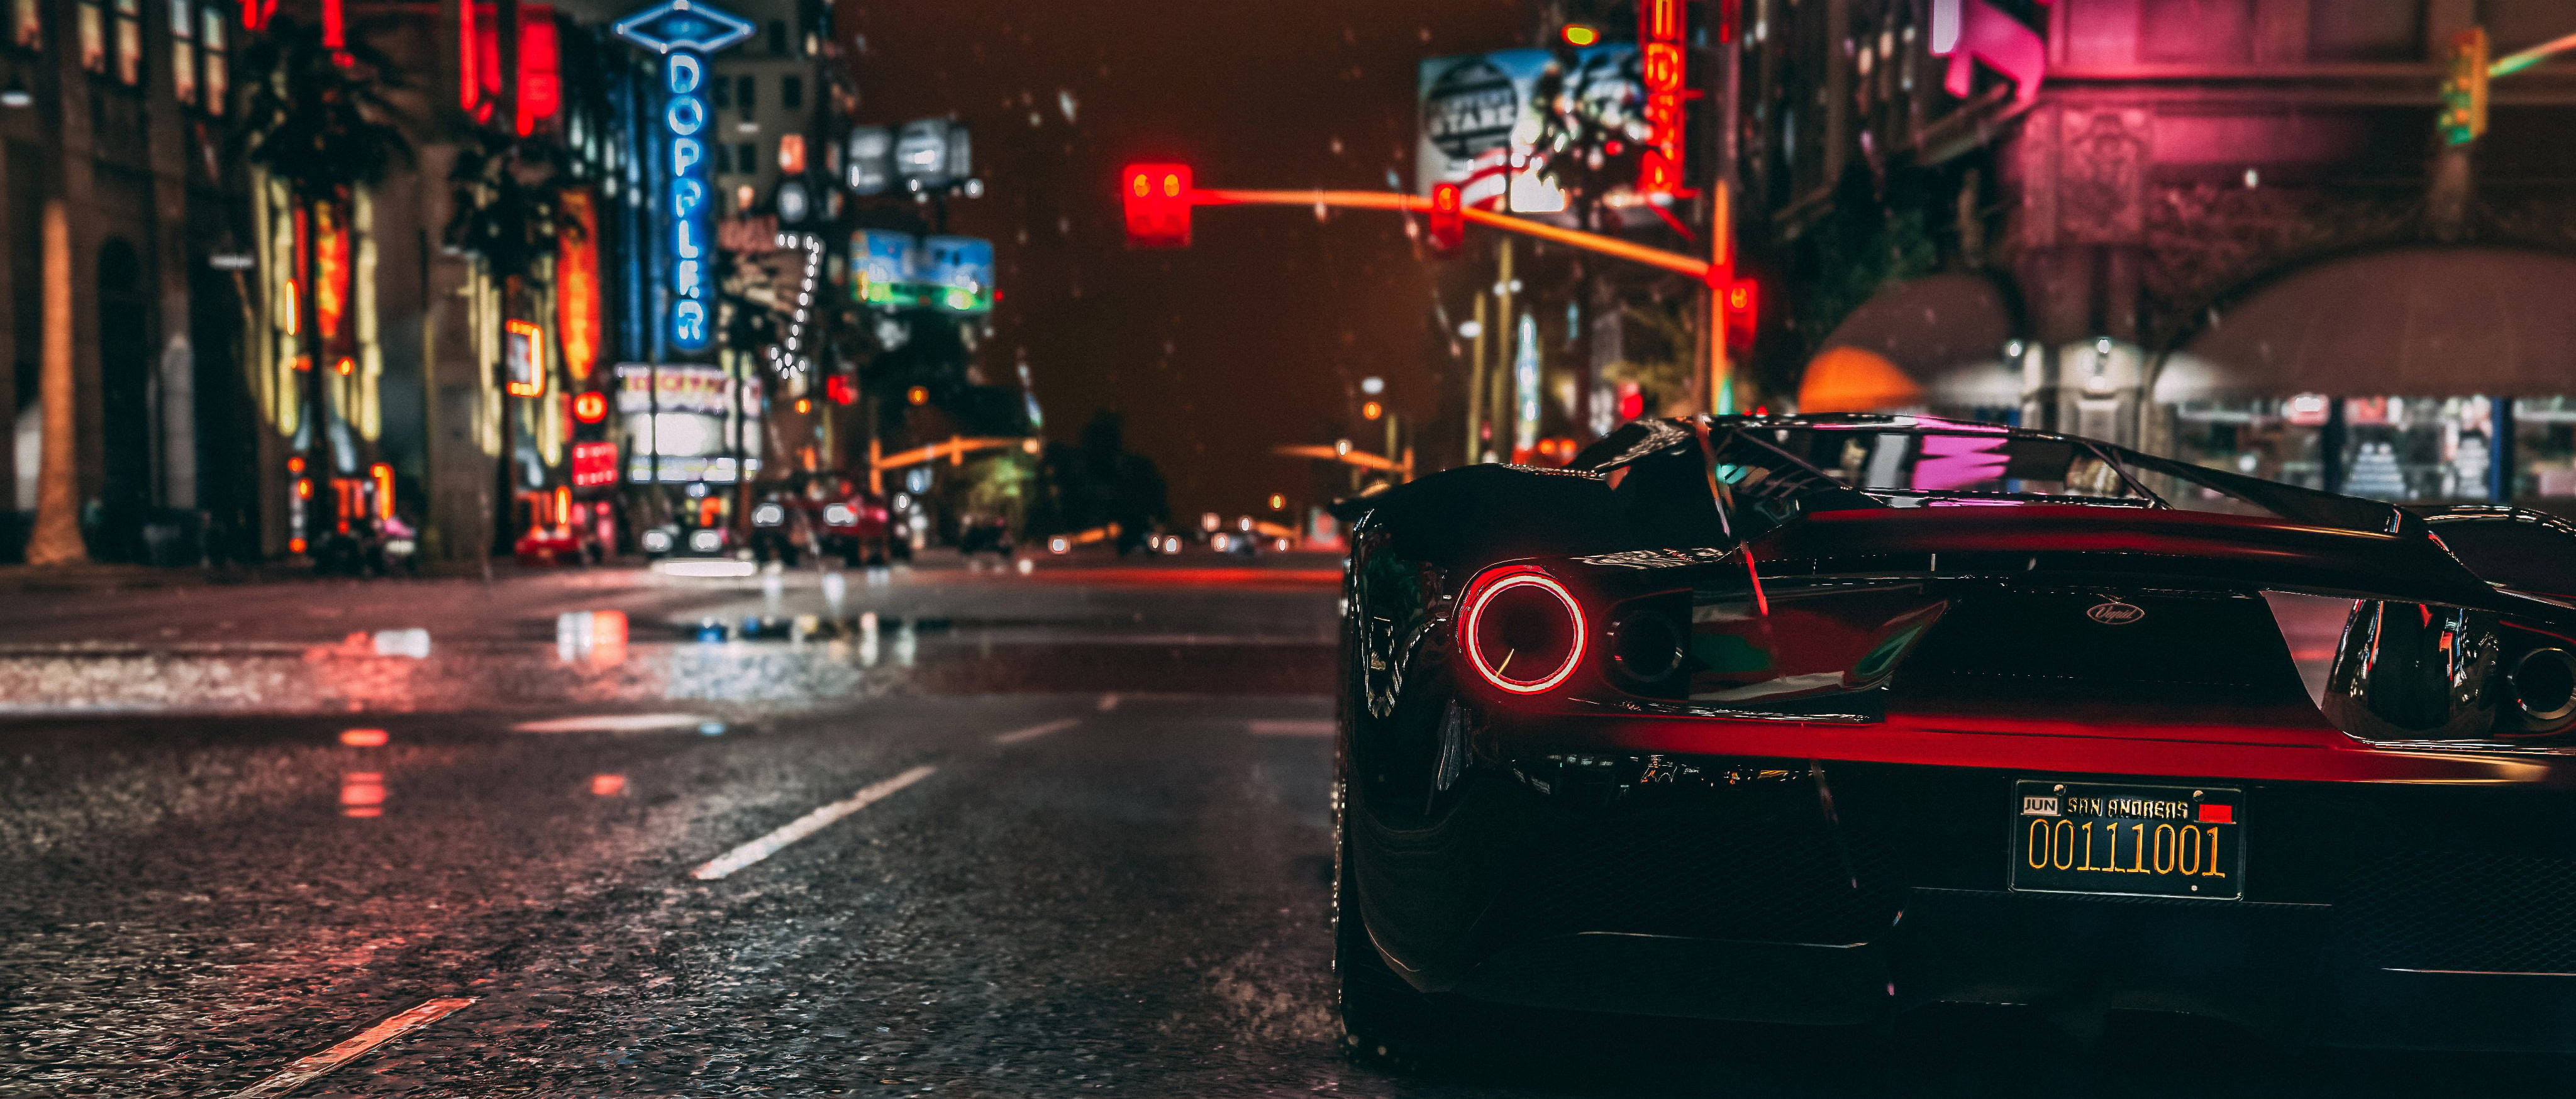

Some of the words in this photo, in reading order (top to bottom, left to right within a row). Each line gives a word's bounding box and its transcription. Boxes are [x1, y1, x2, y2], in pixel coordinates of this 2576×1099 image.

[668, 53, 704, 340] DOPPLER
[2024, 798, 2056, 811] JUN
[2068, 797, 2102, 816] SAN
[2108, 799, 2189, 819] ANDREAS
[2029, 819, 2225, 878] 00111001
